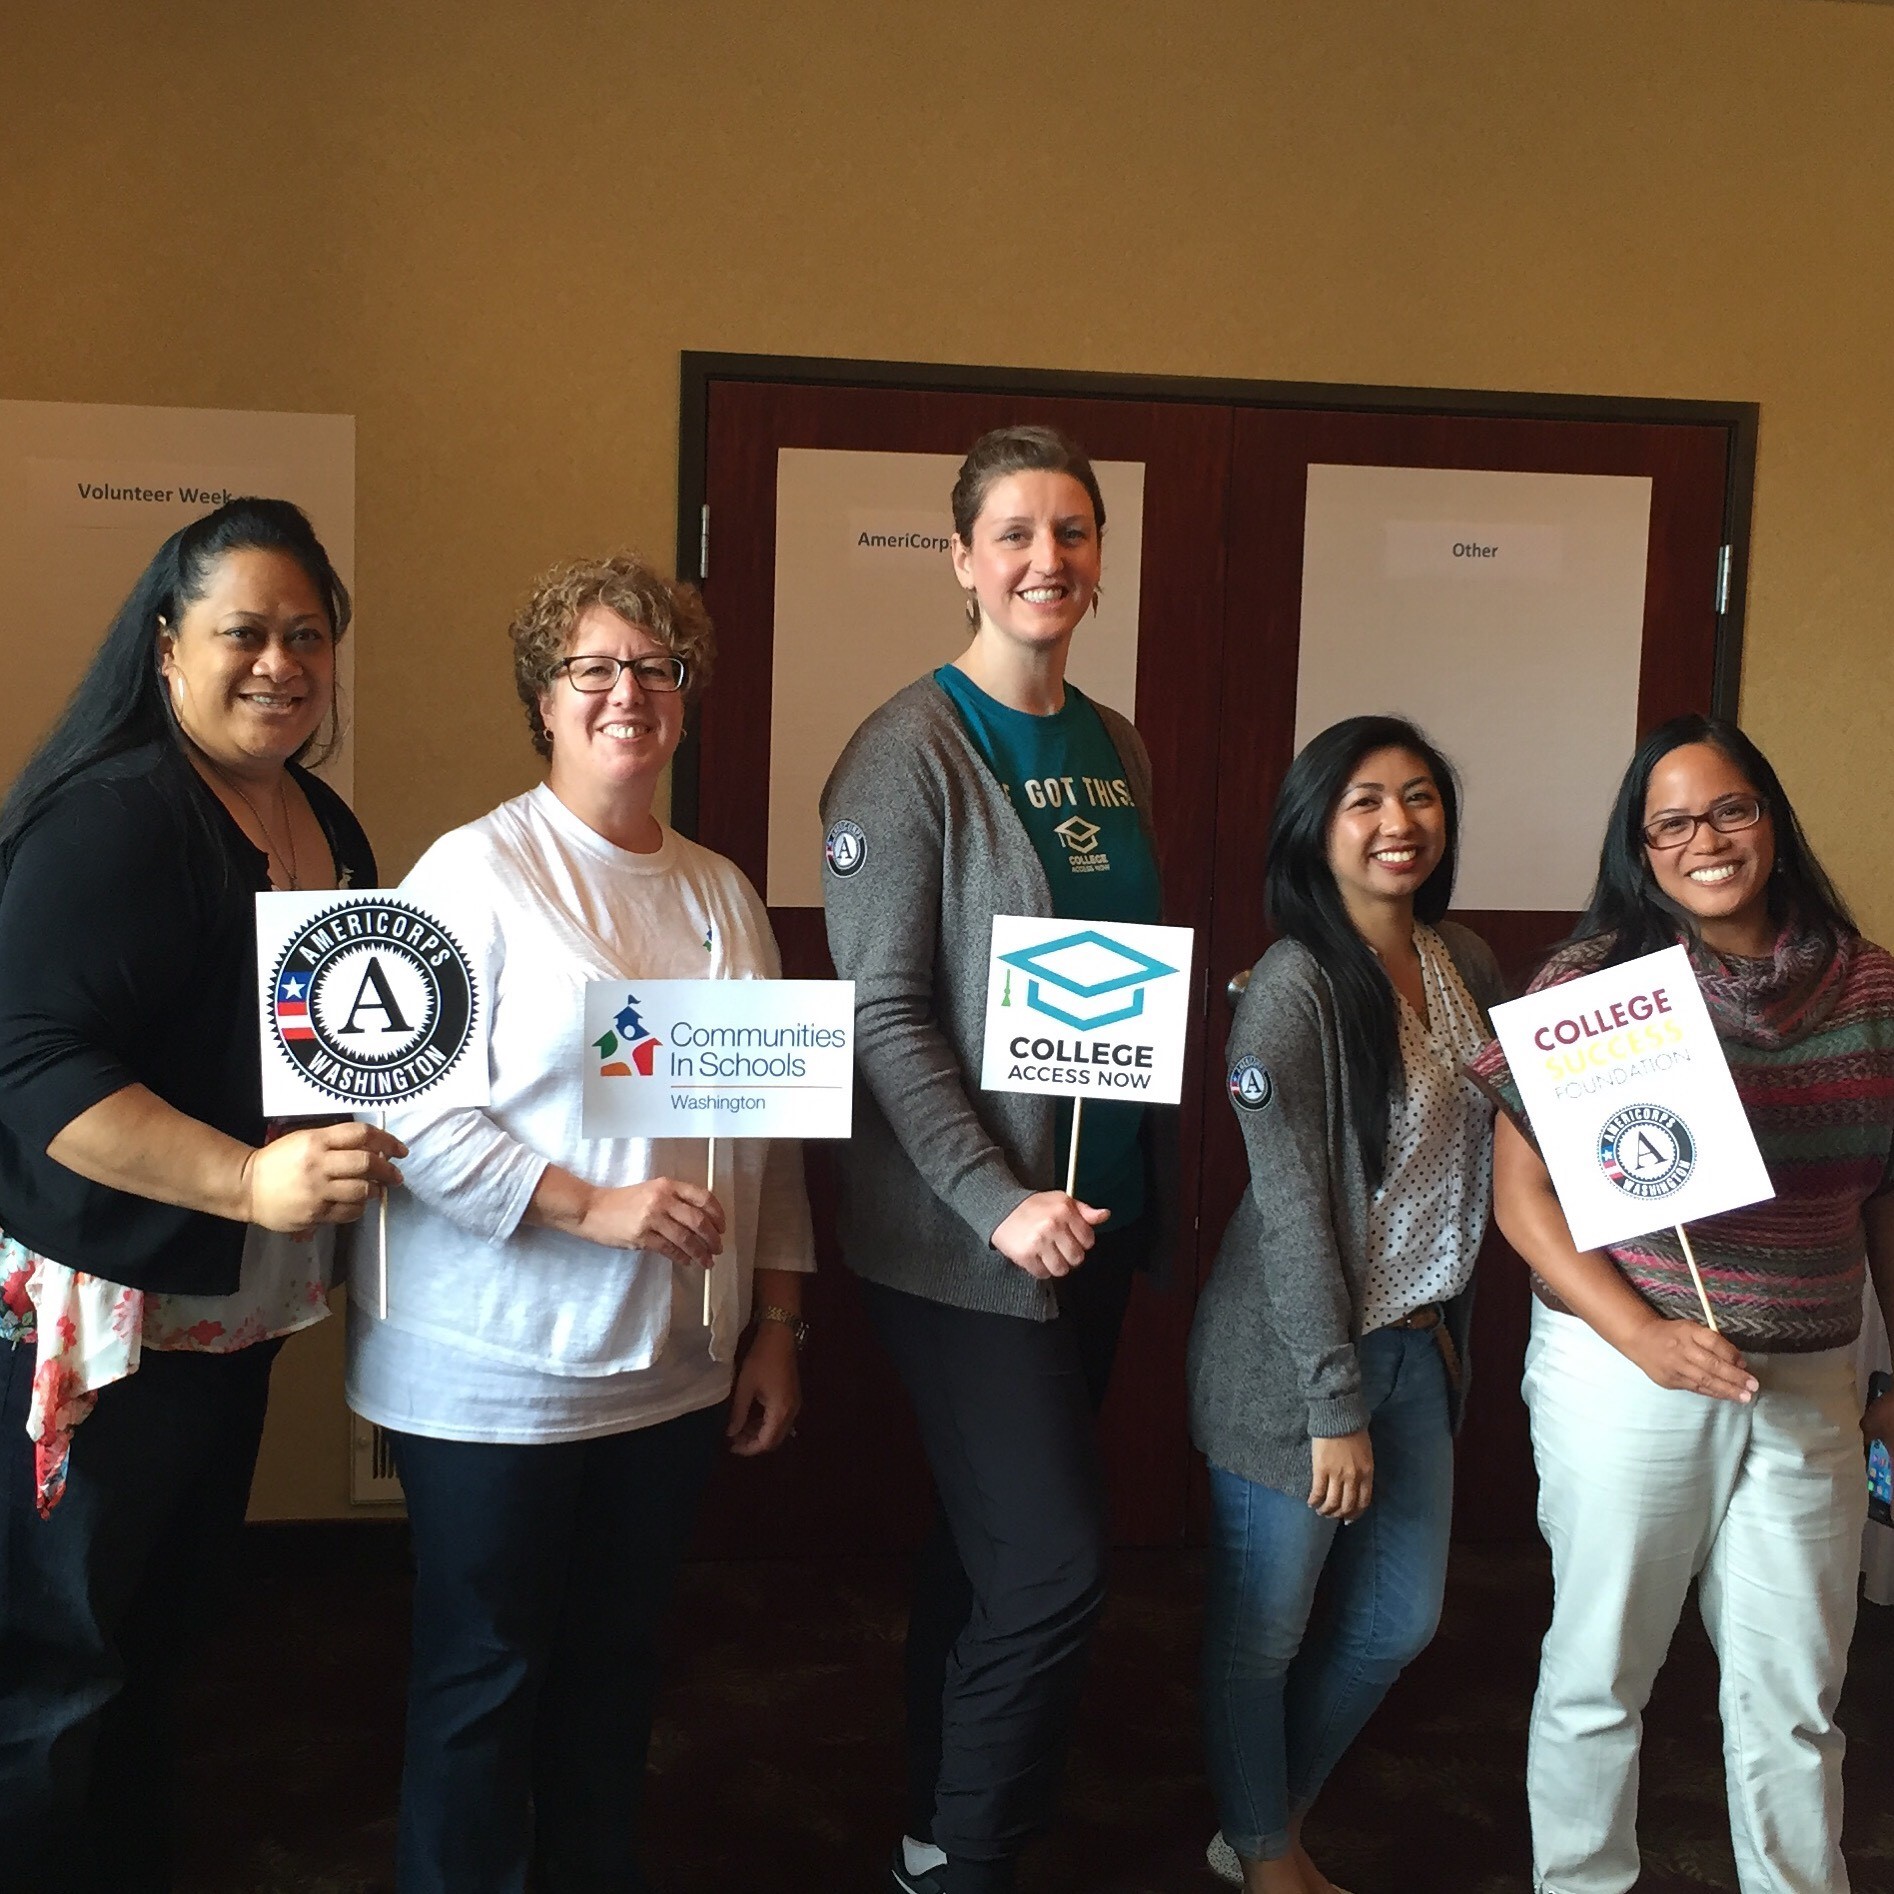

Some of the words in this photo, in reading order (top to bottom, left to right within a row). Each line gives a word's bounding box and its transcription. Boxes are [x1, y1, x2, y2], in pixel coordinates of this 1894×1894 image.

[77, 483, 174, 502] Volunteer
[178, 487, 233, 504] Week
[858, 531, 952, 552] AmeriCorp
[1452, 542, 1499, 558] Other
[1024, 777, 1077, 809] GOT
[836, 836, 853, 859] A
[299, 911, 451, 967] AMERICORPS
[337, 956, 415, 1035] A
[670, 1021, 846, 1048] Communities
[1534, 988, 1673, 1051] COLLEGE
[670, 1052, 693, 1077] In
[699, 1052, 806, 1077] Schools
[1009, 1036, 1154, 1069] COLLEGE
[1545, 1018, 1684, 1081] SUCCESS
[307, 1044, 448, 1095] WASHINGTON
[1007, 1064, 1091, 1085] ACCESS
[1097, 1070, 1152, 1089] NOW
[1244, 1070, 1262, 1093] A
[1554, 1048, 1692, 1100] FOUNDATION
[670, 1094, 766, 1113] Washington
[1603, 1108, 1676, 1142] AMERICORPS
[1634, 1130, 1669, 1171] A
[1622, 1159, 1691, 1197] WASHINGTON
